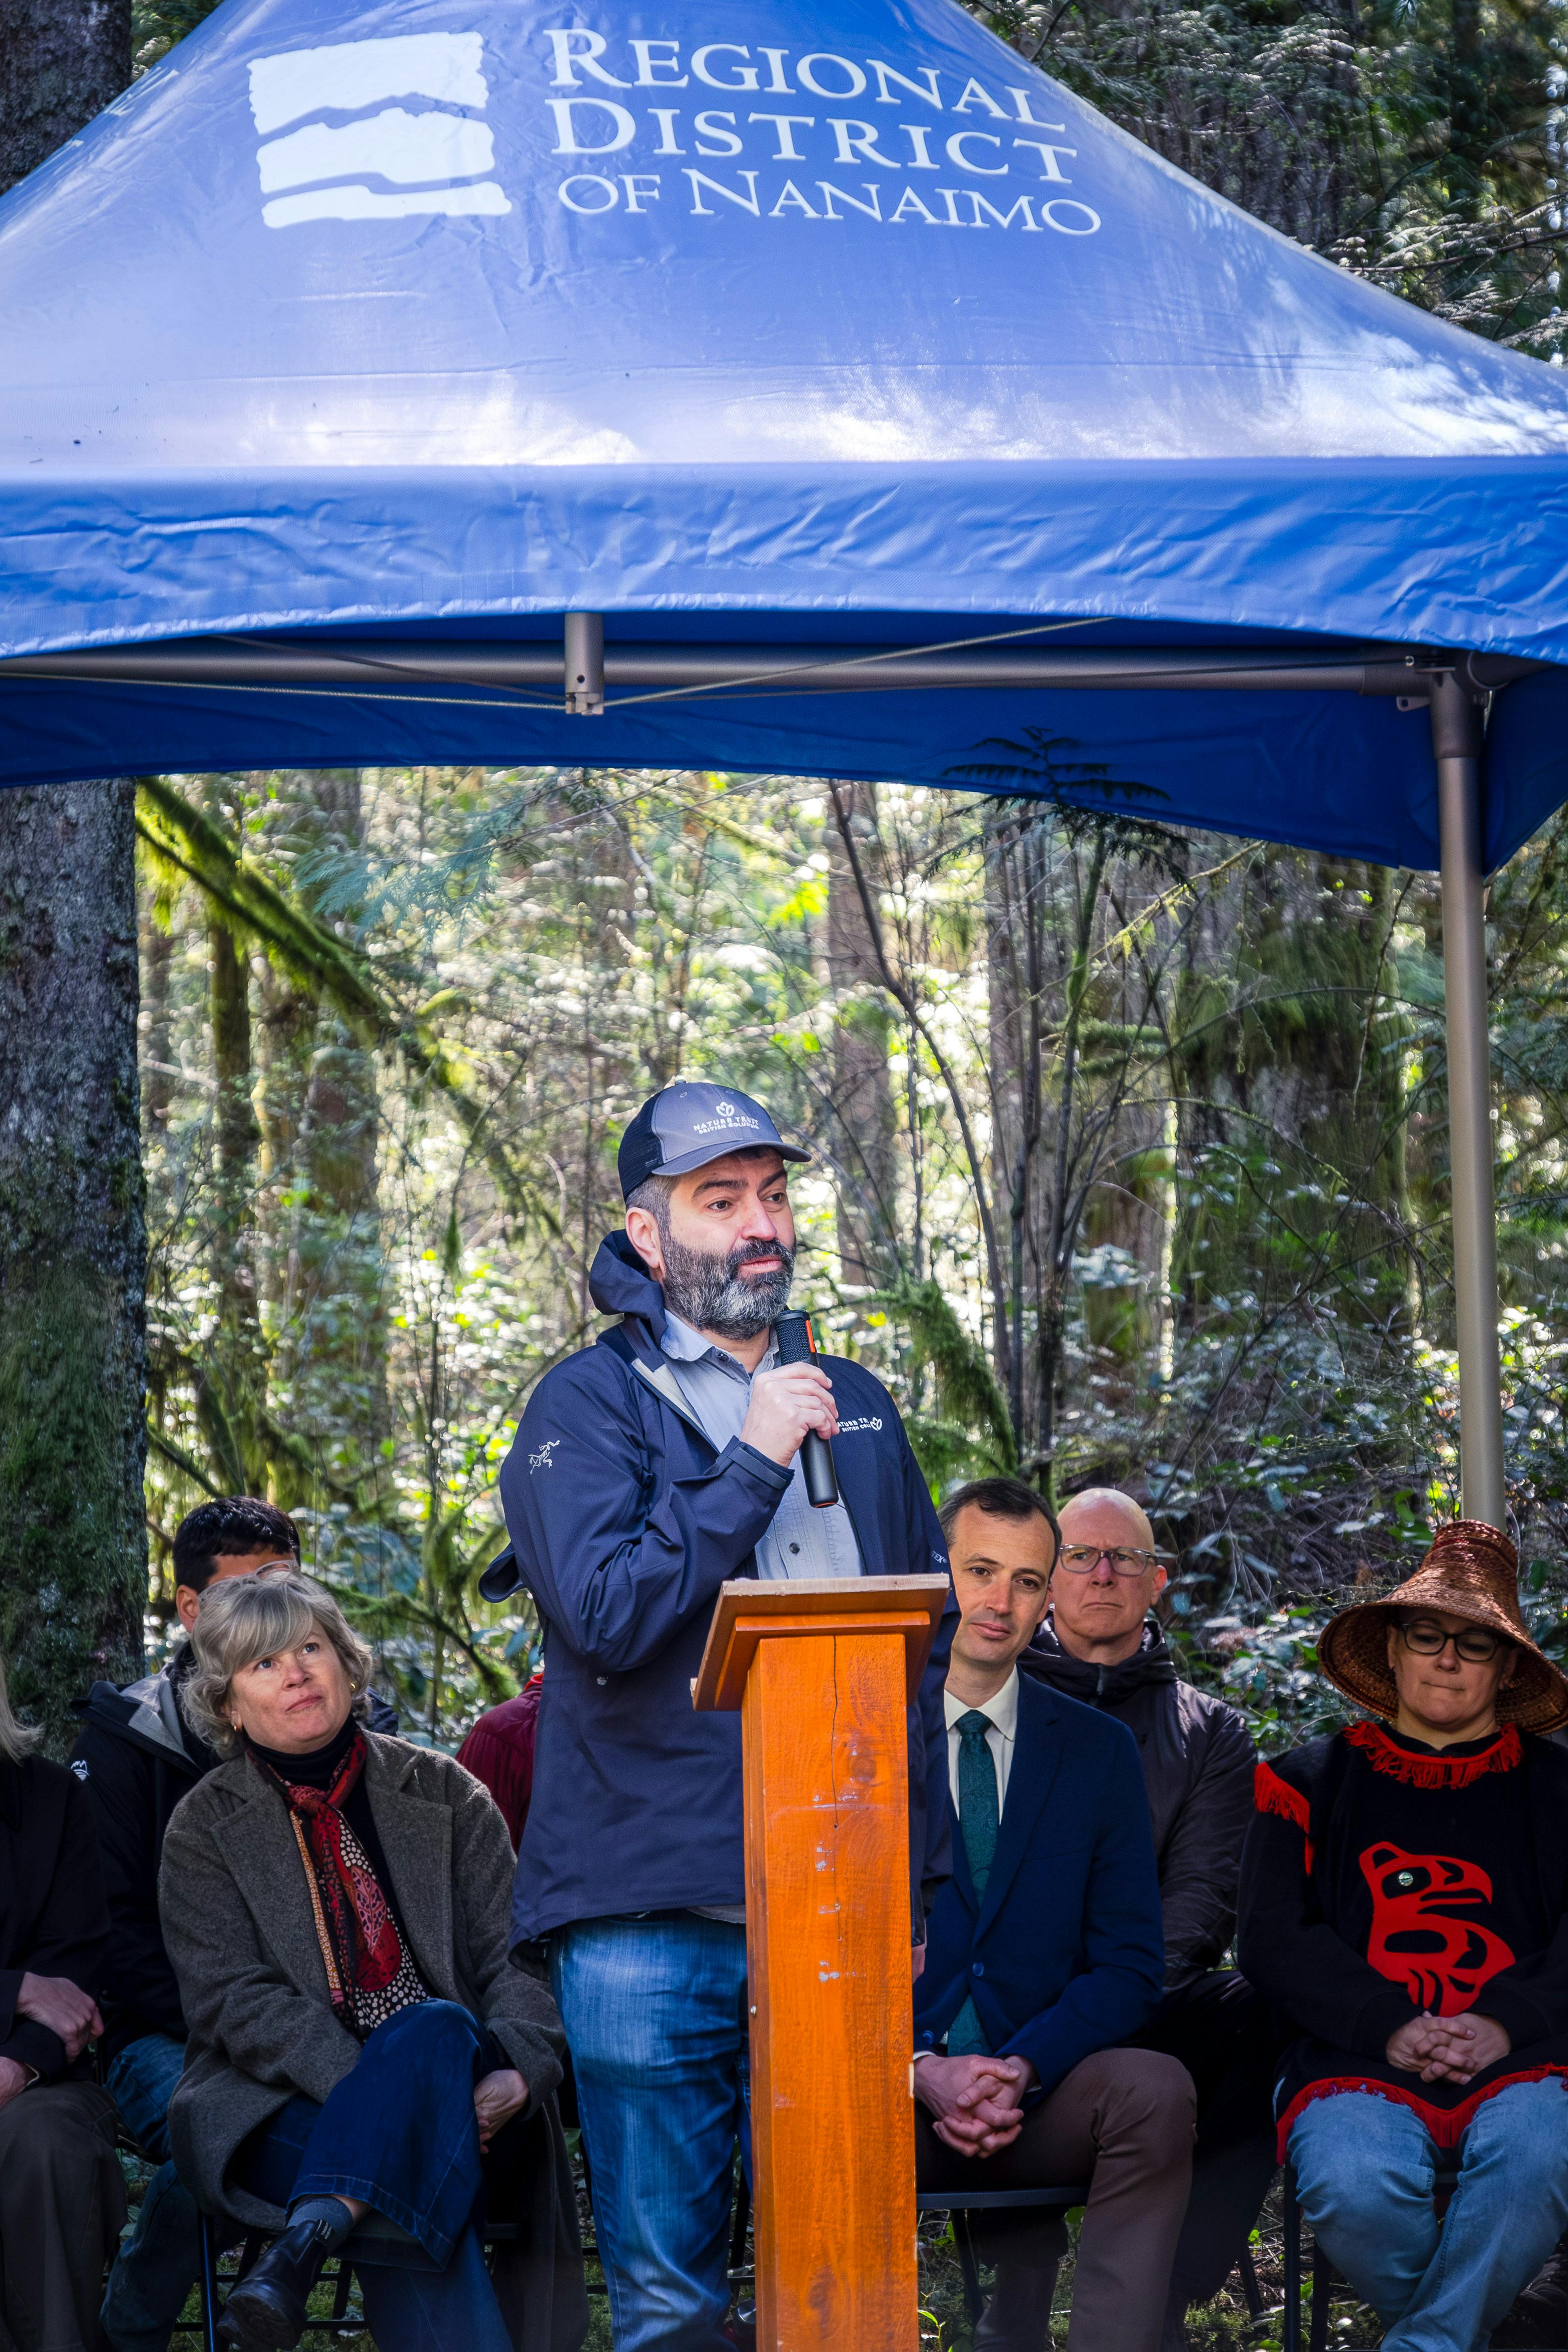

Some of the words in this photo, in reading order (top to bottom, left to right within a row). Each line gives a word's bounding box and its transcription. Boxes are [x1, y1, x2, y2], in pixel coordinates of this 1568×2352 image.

[543, 28, 1066, 133] REGIONAL
[544, 97, 1077, 183] DISTRICT
[557, 174, 661, 214] OF
[682, 168, 1102, 235] NANAIMO
[693, 1117, 732, 1131] NATURE
[735, 1116, 759, 1126] TRUST
[698, 1124, 726, 1134] BRITISH
